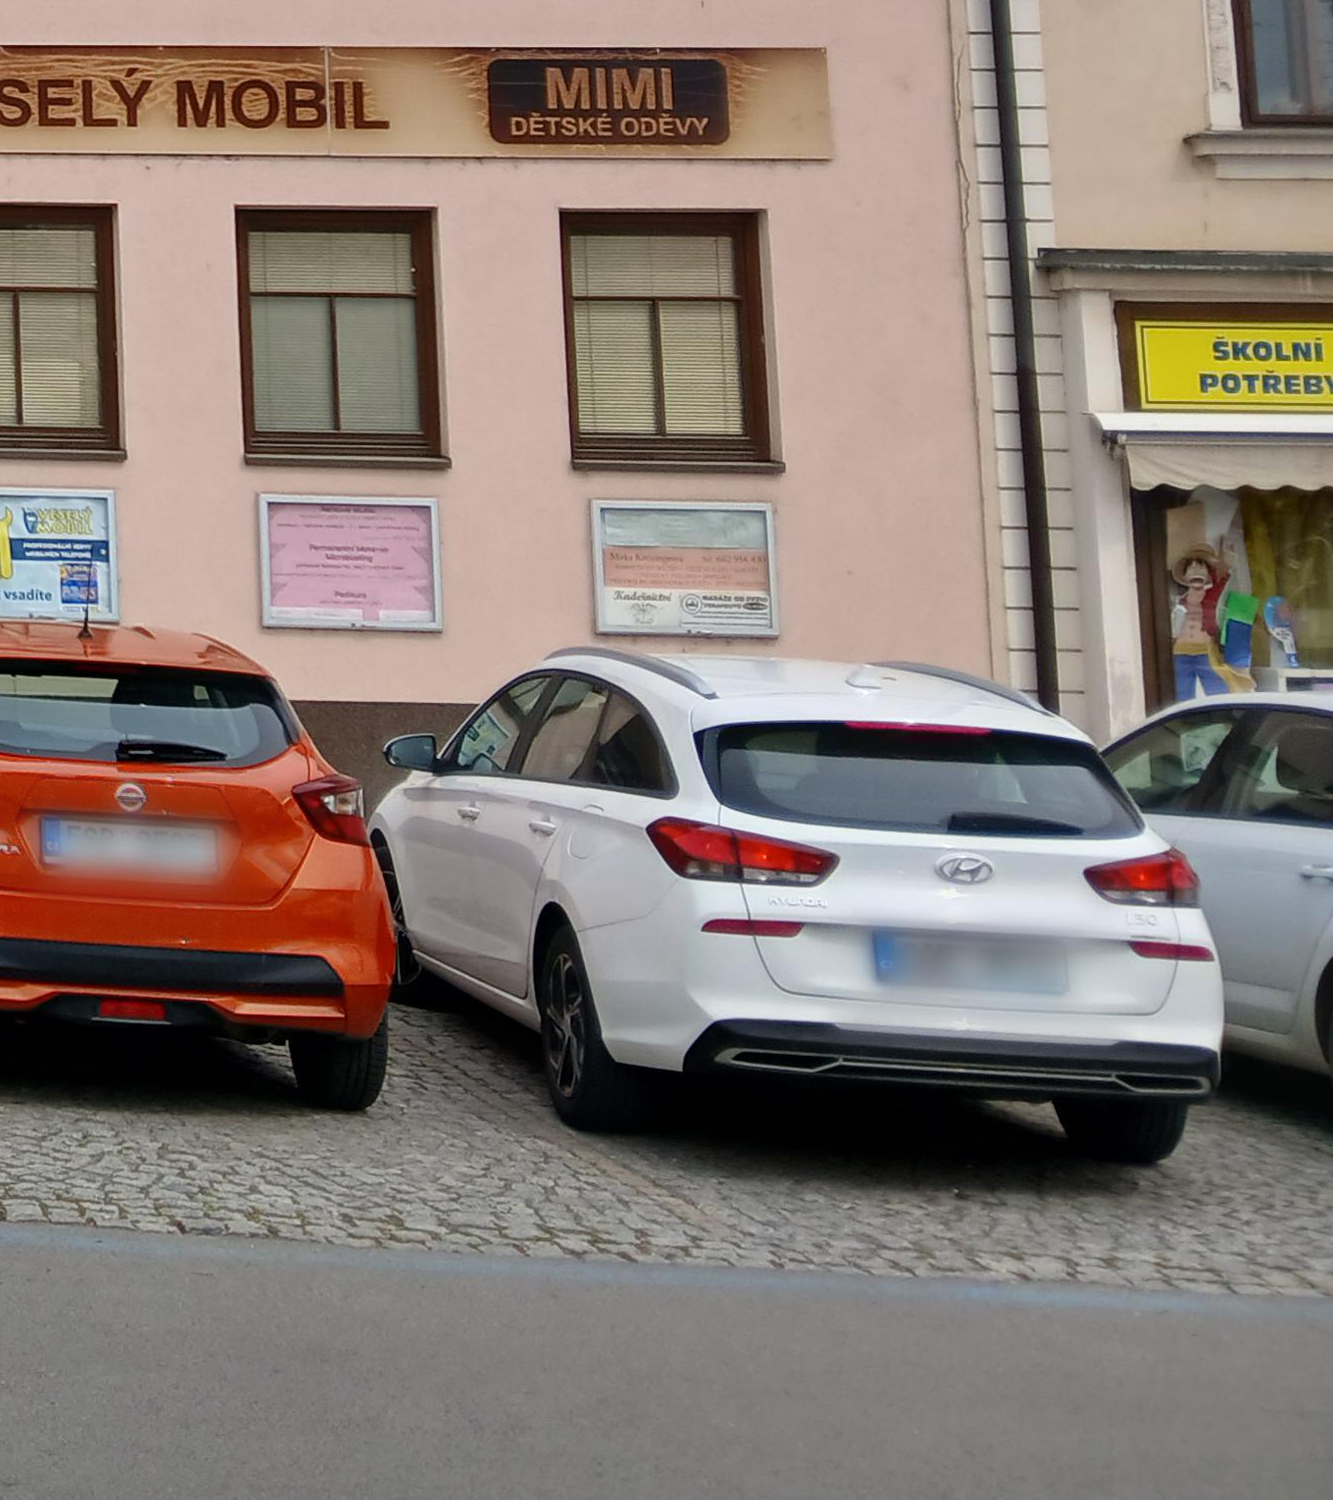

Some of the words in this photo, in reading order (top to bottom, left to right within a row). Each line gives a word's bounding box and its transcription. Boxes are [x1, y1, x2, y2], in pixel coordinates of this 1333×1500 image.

[545, 67, 674, 111] MIMI
[176, 80, 390, 130] MOBIL
[510, 112, 614, 137] DĚTSKÉ
[620, 113, 709, 137] ODĚVY
[1212, 336, 1324, 363] ŠKOLNÍ
[767, 896, 828, 908] HYUNDAI
